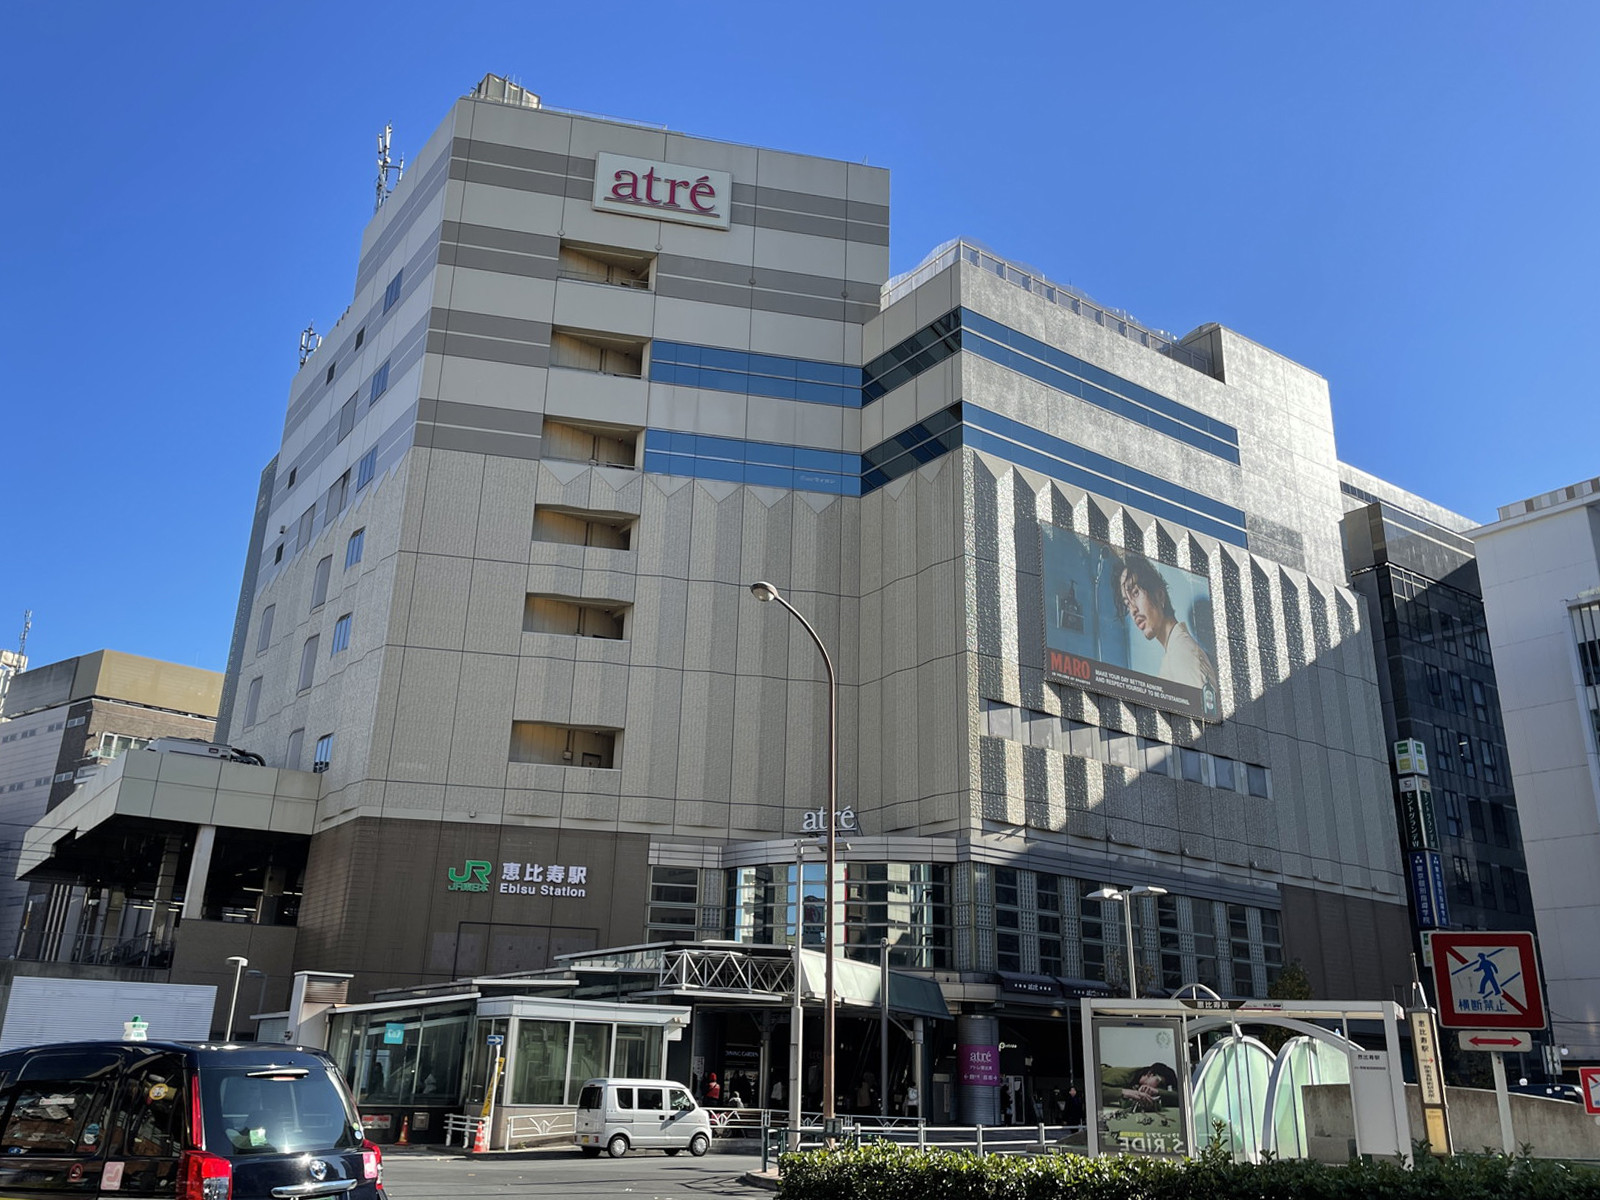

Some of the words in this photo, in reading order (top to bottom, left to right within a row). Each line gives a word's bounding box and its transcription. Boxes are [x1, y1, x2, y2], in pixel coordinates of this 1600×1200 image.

[611, 166, 716, 213] atré
[1050, 652, 1091, 680] MARO
[448, 860, 492, 884] JR
[501, 862, 588, 885] 恵比寿駅
[500, 883, 536, 895] Ebisu
[540, 885, 586, 898] Station
[1458, 998, 1508, 1013] 横断禁止
[1418, 1019, 1430, 1053] 恵比寿駅
[969, 1051, 993, 1062] atré
